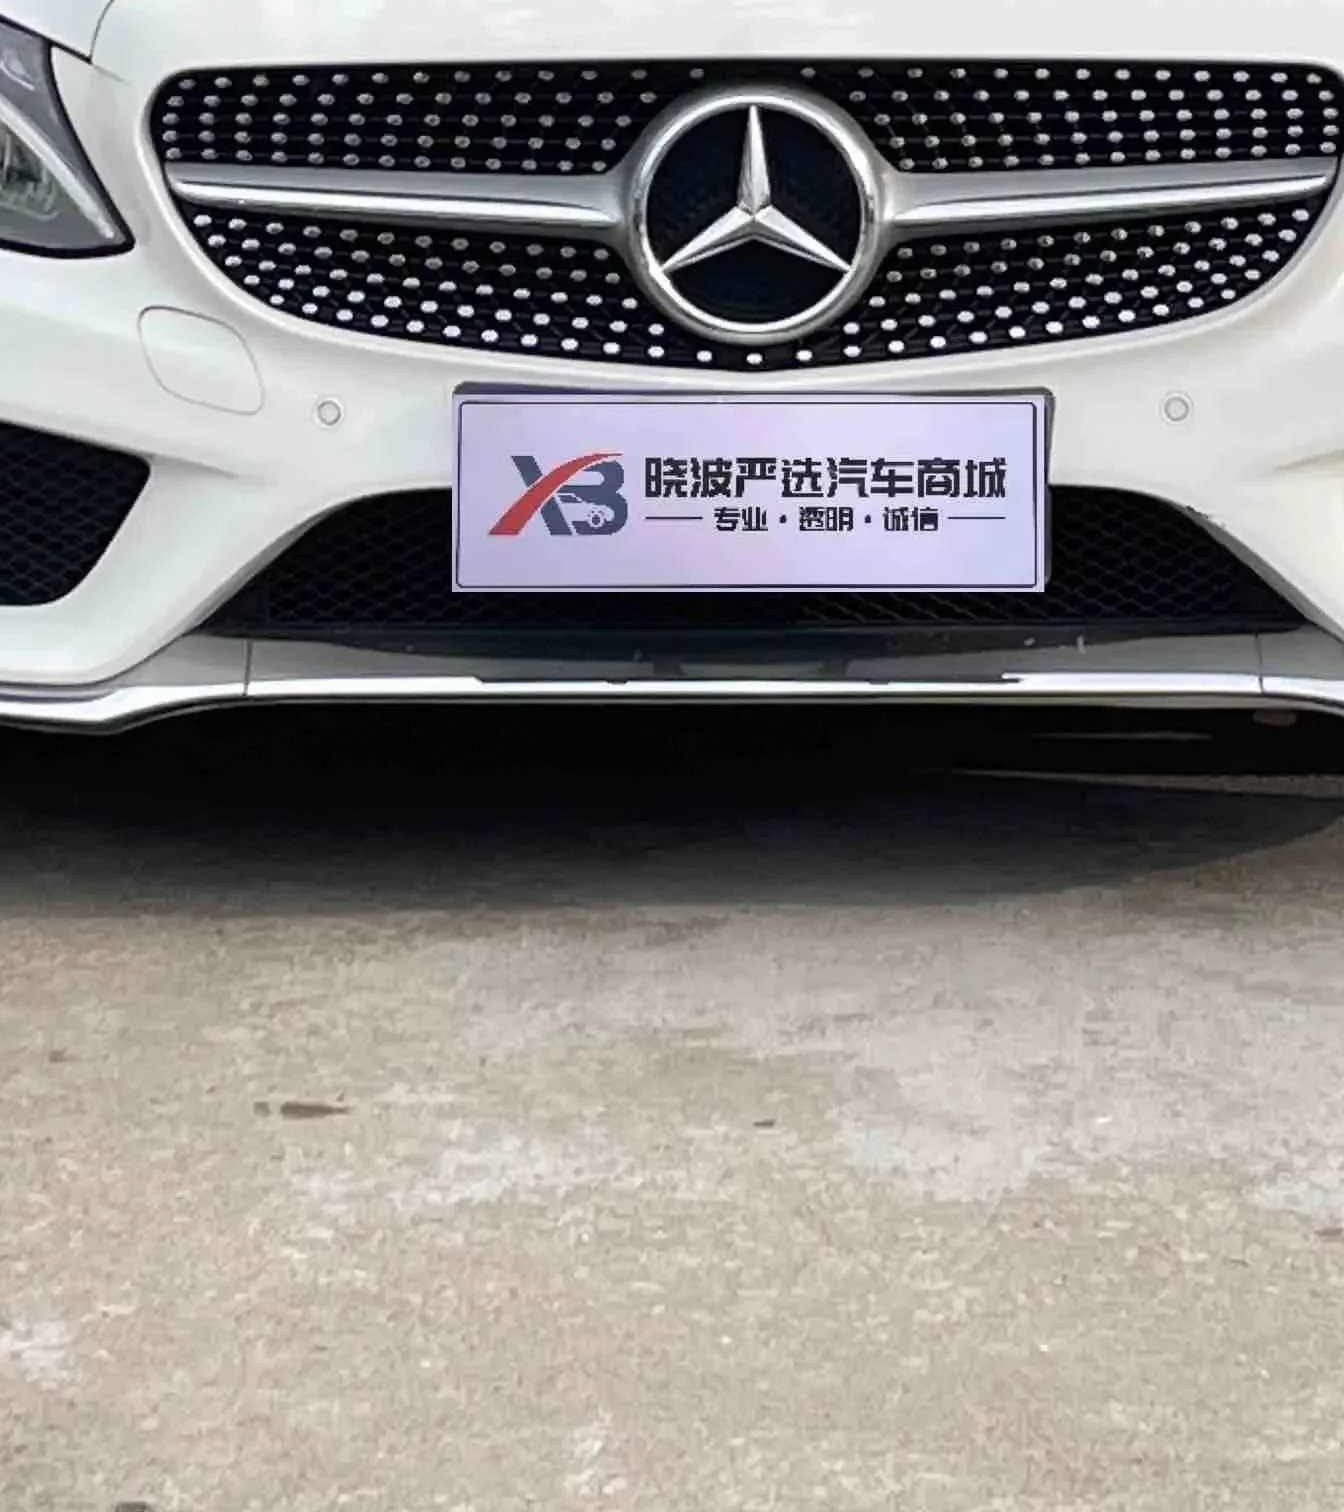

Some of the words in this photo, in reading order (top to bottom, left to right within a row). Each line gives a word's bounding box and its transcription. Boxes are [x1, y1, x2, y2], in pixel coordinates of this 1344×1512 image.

[644, 457, 1007, 498] 晓波严选汽车商城
